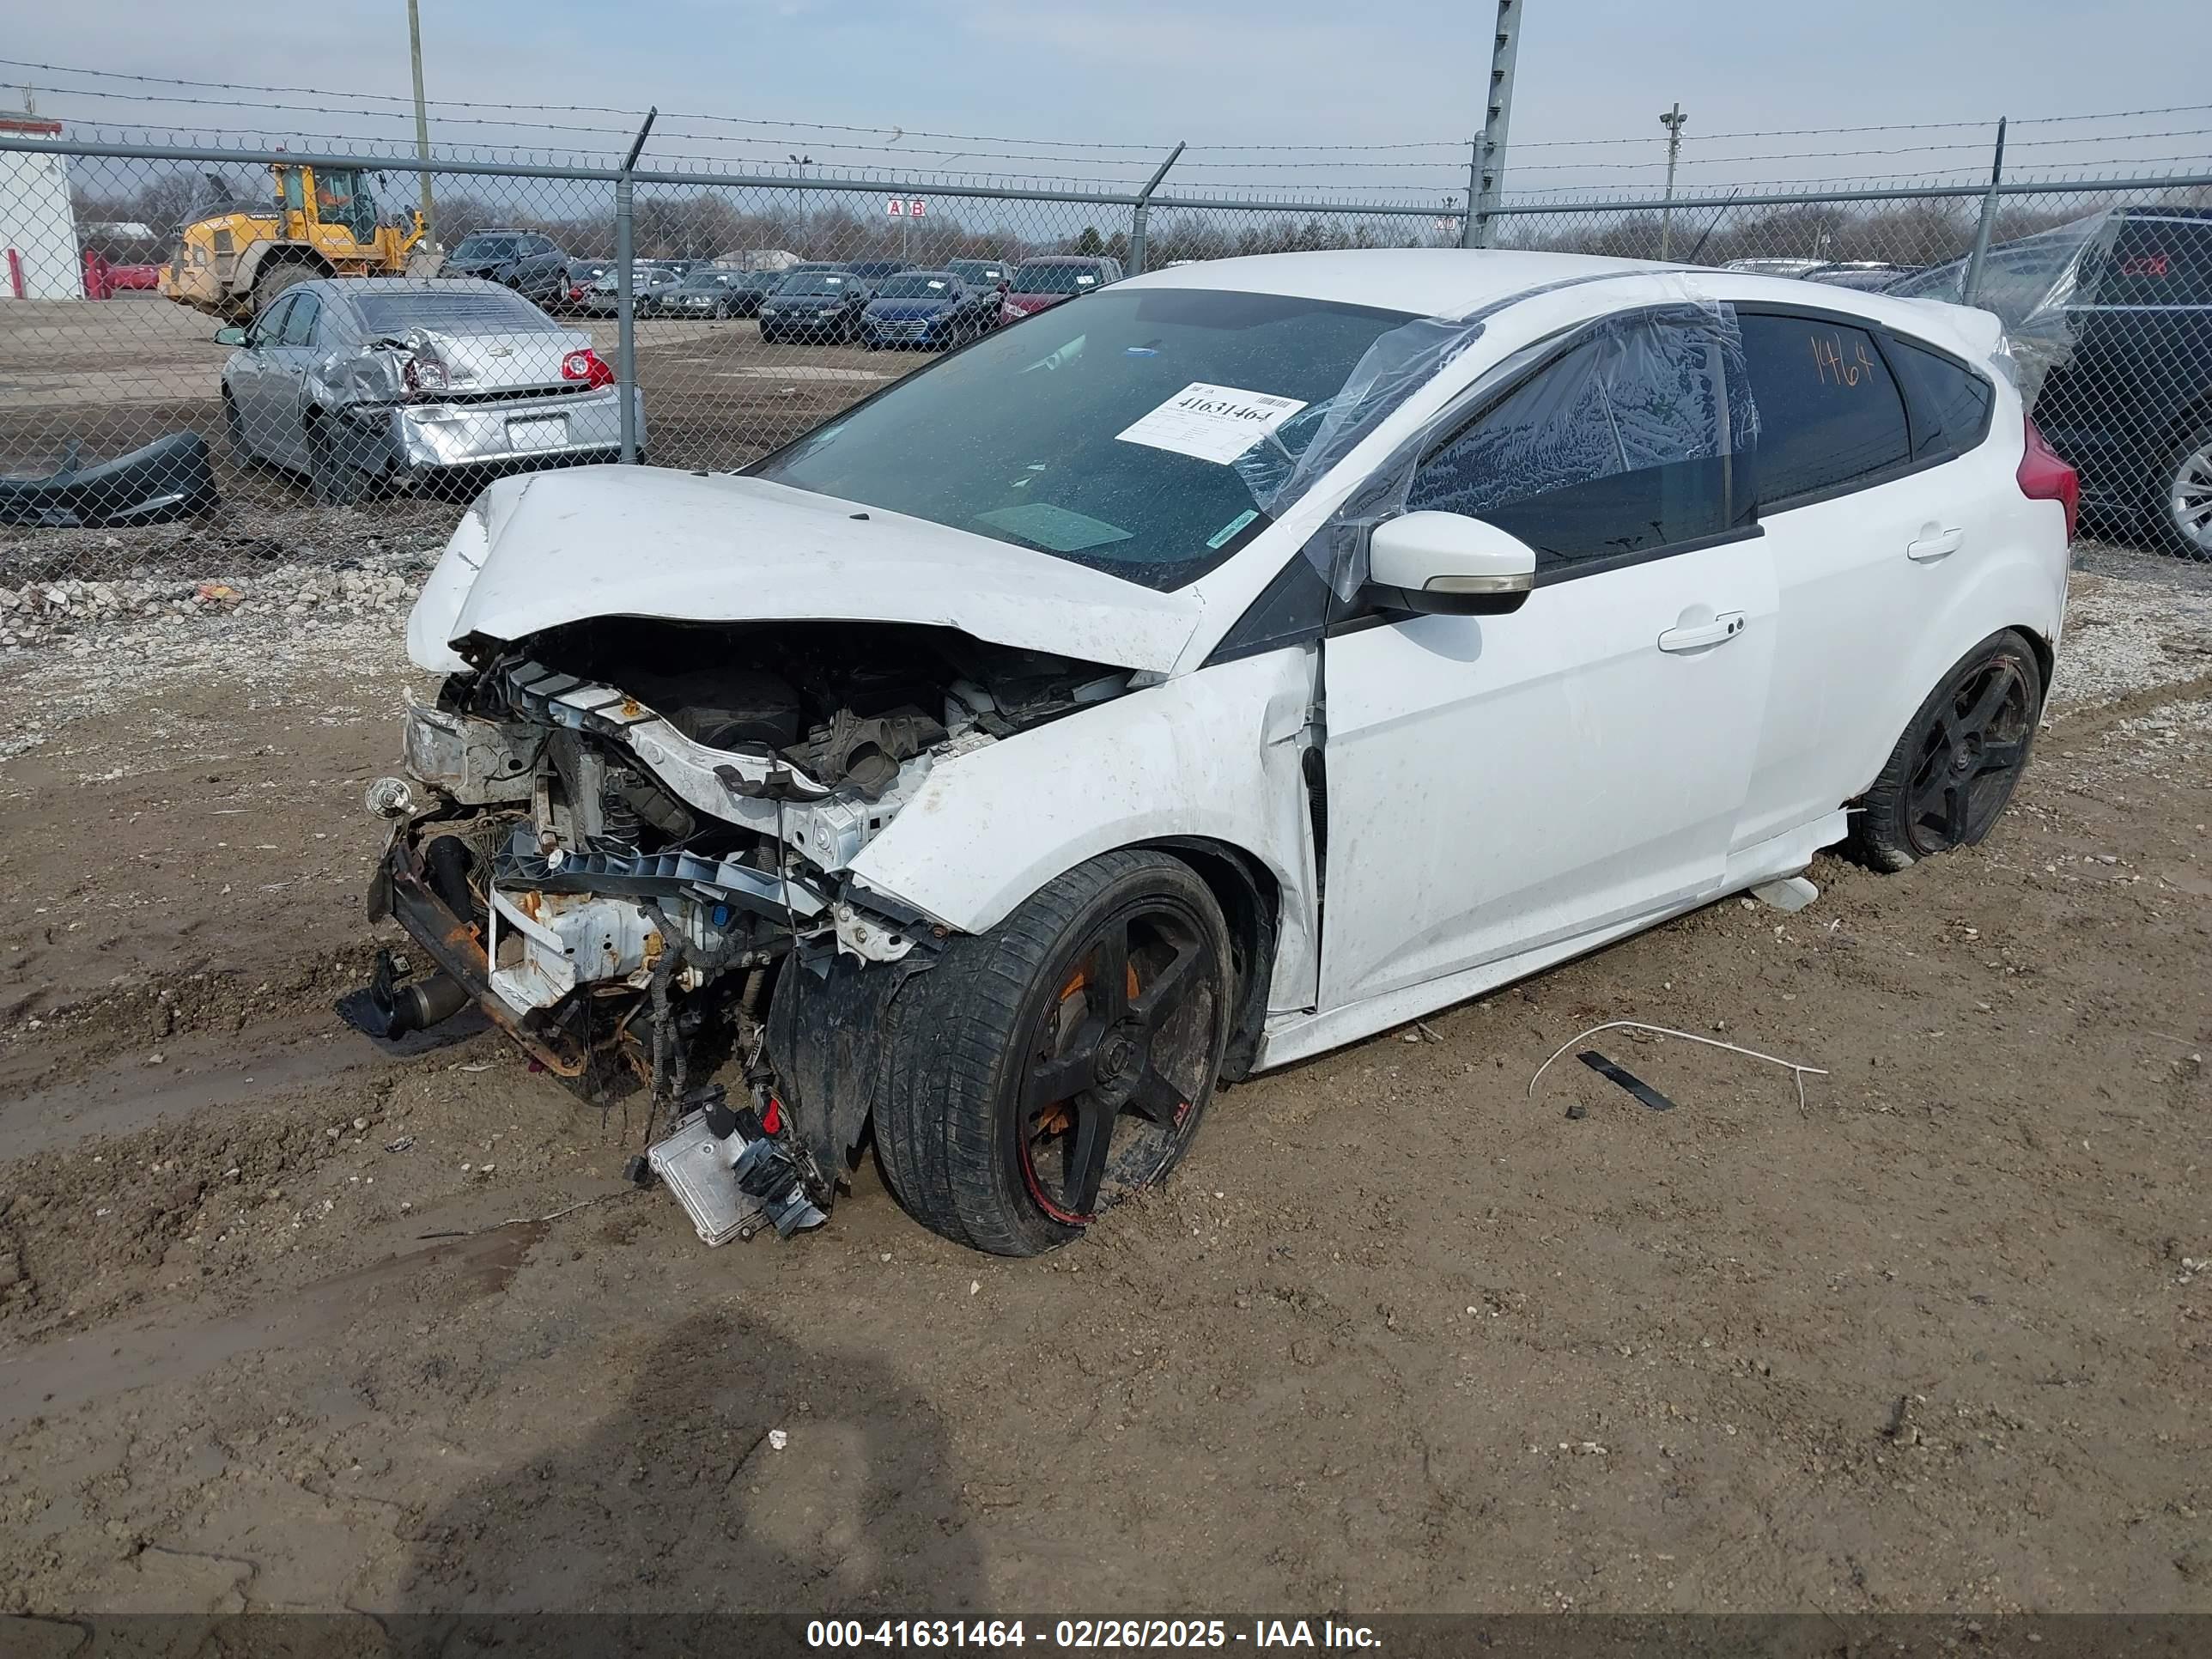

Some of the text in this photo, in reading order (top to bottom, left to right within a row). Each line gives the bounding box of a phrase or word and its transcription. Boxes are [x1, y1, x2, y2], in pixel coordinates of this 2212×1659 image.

[890, 201, 900, 214] A
[913, 202, 923, 215] B
[1810, 331, 1875, 386] 1464
[1178, 397, 1274, 422] 41631464
